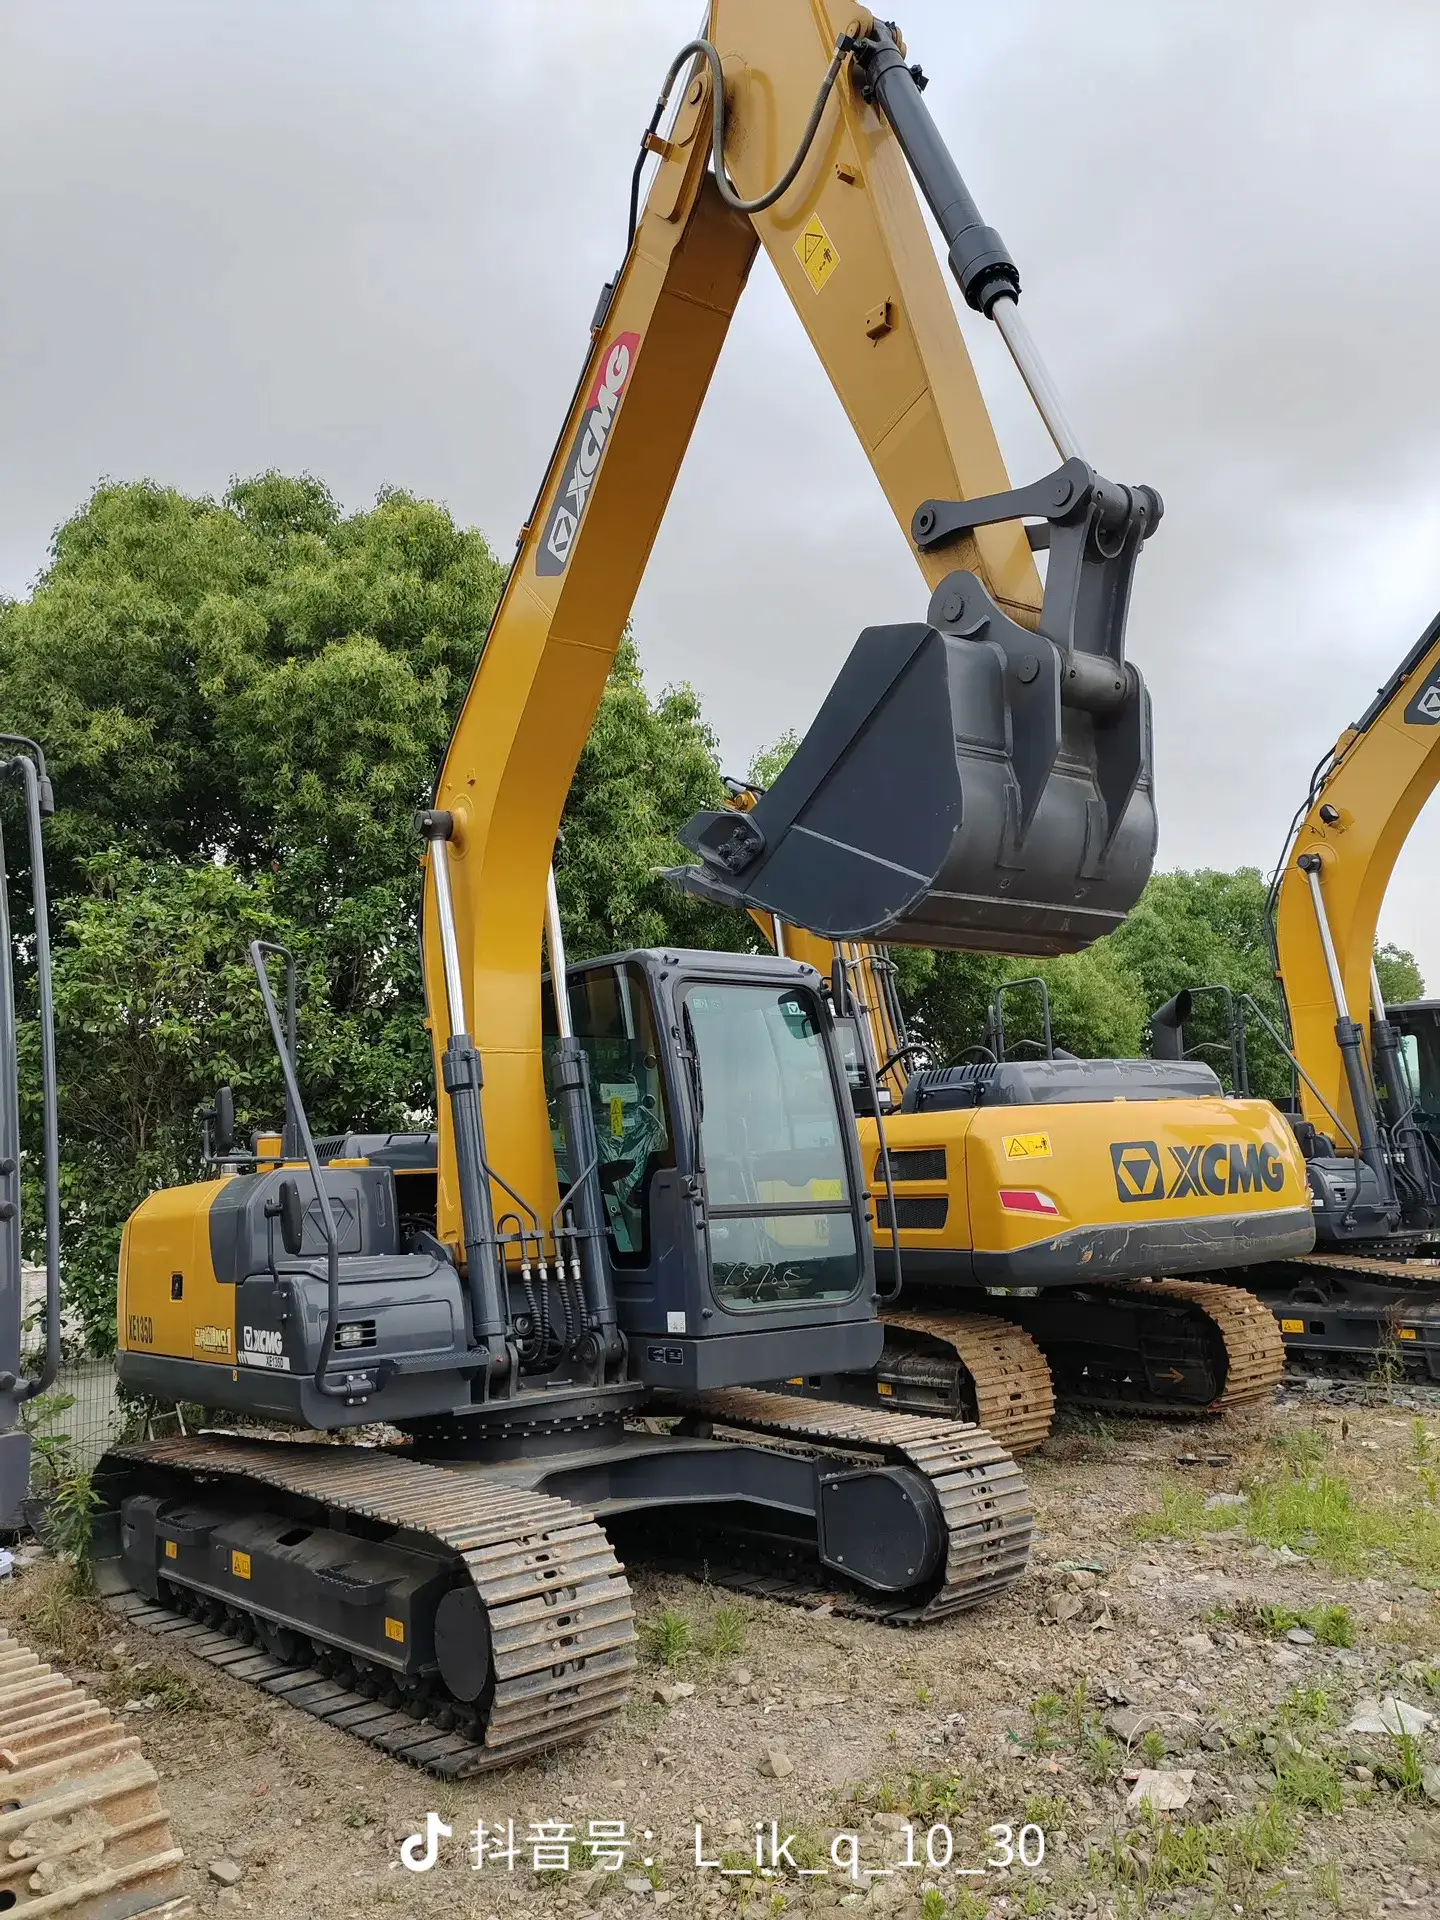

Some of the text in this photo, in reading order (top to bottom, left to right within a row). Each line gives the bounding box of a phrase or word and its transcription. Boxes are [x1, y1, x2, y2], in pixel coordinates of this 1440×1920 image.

[565, 344, 630, 519] XCMG
[1166, 1141, 1285, 1198] XCMG
[128, 1314, 153, 1344] XE135D
[253, 1329, 283, 1355] XCMG
